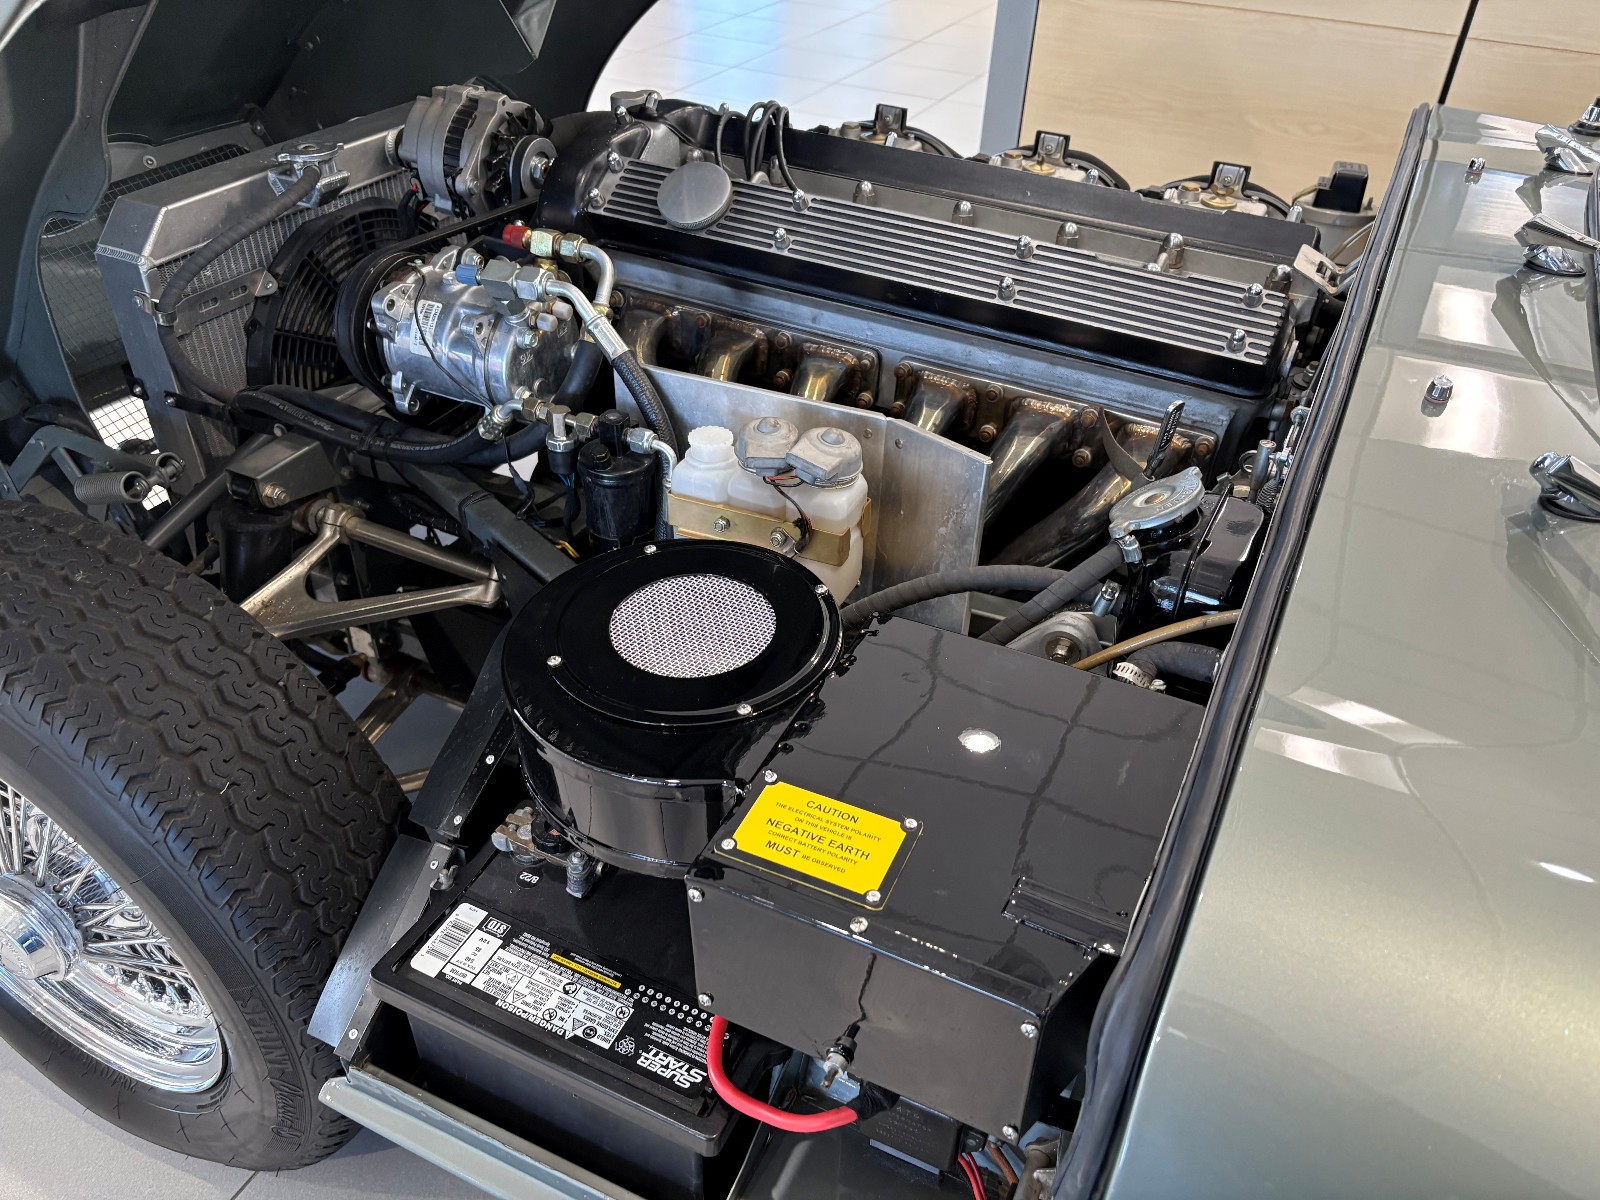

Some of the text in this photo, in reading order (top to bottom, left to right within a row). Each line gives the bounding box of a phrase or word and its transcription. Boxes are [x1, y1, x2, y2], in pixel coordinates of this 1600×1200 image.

[775, 802, 882, 842] THE ELECTRICAL SYSTEM POLARITY
[805, 820, 818, 829] THIS
[819, 825, 845, 838] VEHICLE
[806, 800, 859, 824] CAUTION
[766, 817, 871, 860] NEGATIVE EARTH
[768, 830, 859, 865] CORRECT BATTERY POLARITY
[765, 840, 801, 858] MUST
[812, 857, 846, 874] OBSERVED
[519, 871, 539, 883] 8/22
[487, 920, 507, 934] STD
[237, 998, 291, 1071] SPRINT
[495, 1000, 566, 1036] DANGER/POISON
[637, 1056, 690, 1088] SUPER
[641, 1049, 707, 1083] START
